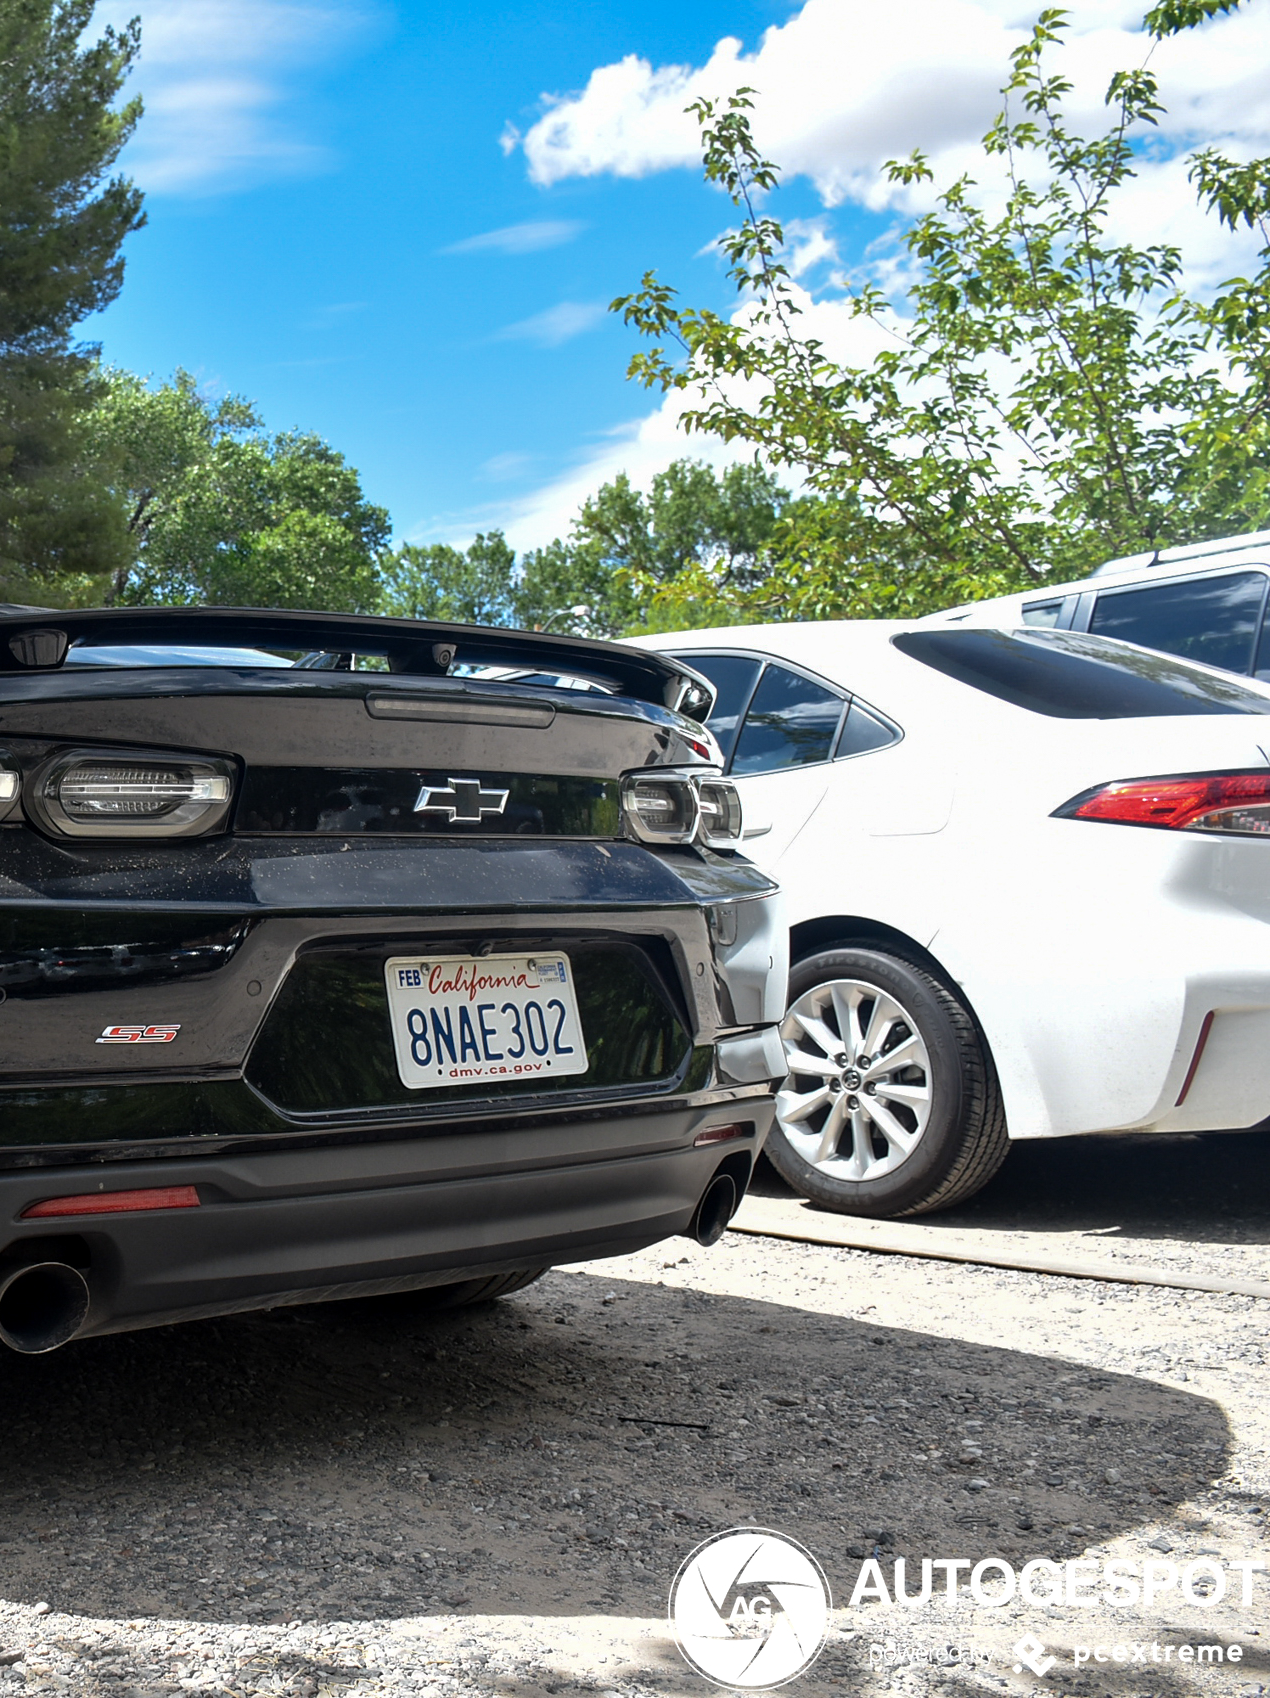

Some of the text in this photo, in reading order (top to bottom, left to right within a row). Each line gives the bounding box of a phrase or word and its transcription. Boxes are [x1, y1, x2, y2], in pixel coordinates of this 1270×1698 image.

[398, 968, 422, 988] FEB
[429, 964, 540, 1001] California
[95, 1024, 182, 1044] SS
[407, 999, 574, 1067] 8NAE302
[449, 1063, 543, 1078] dmv.ca.gov
